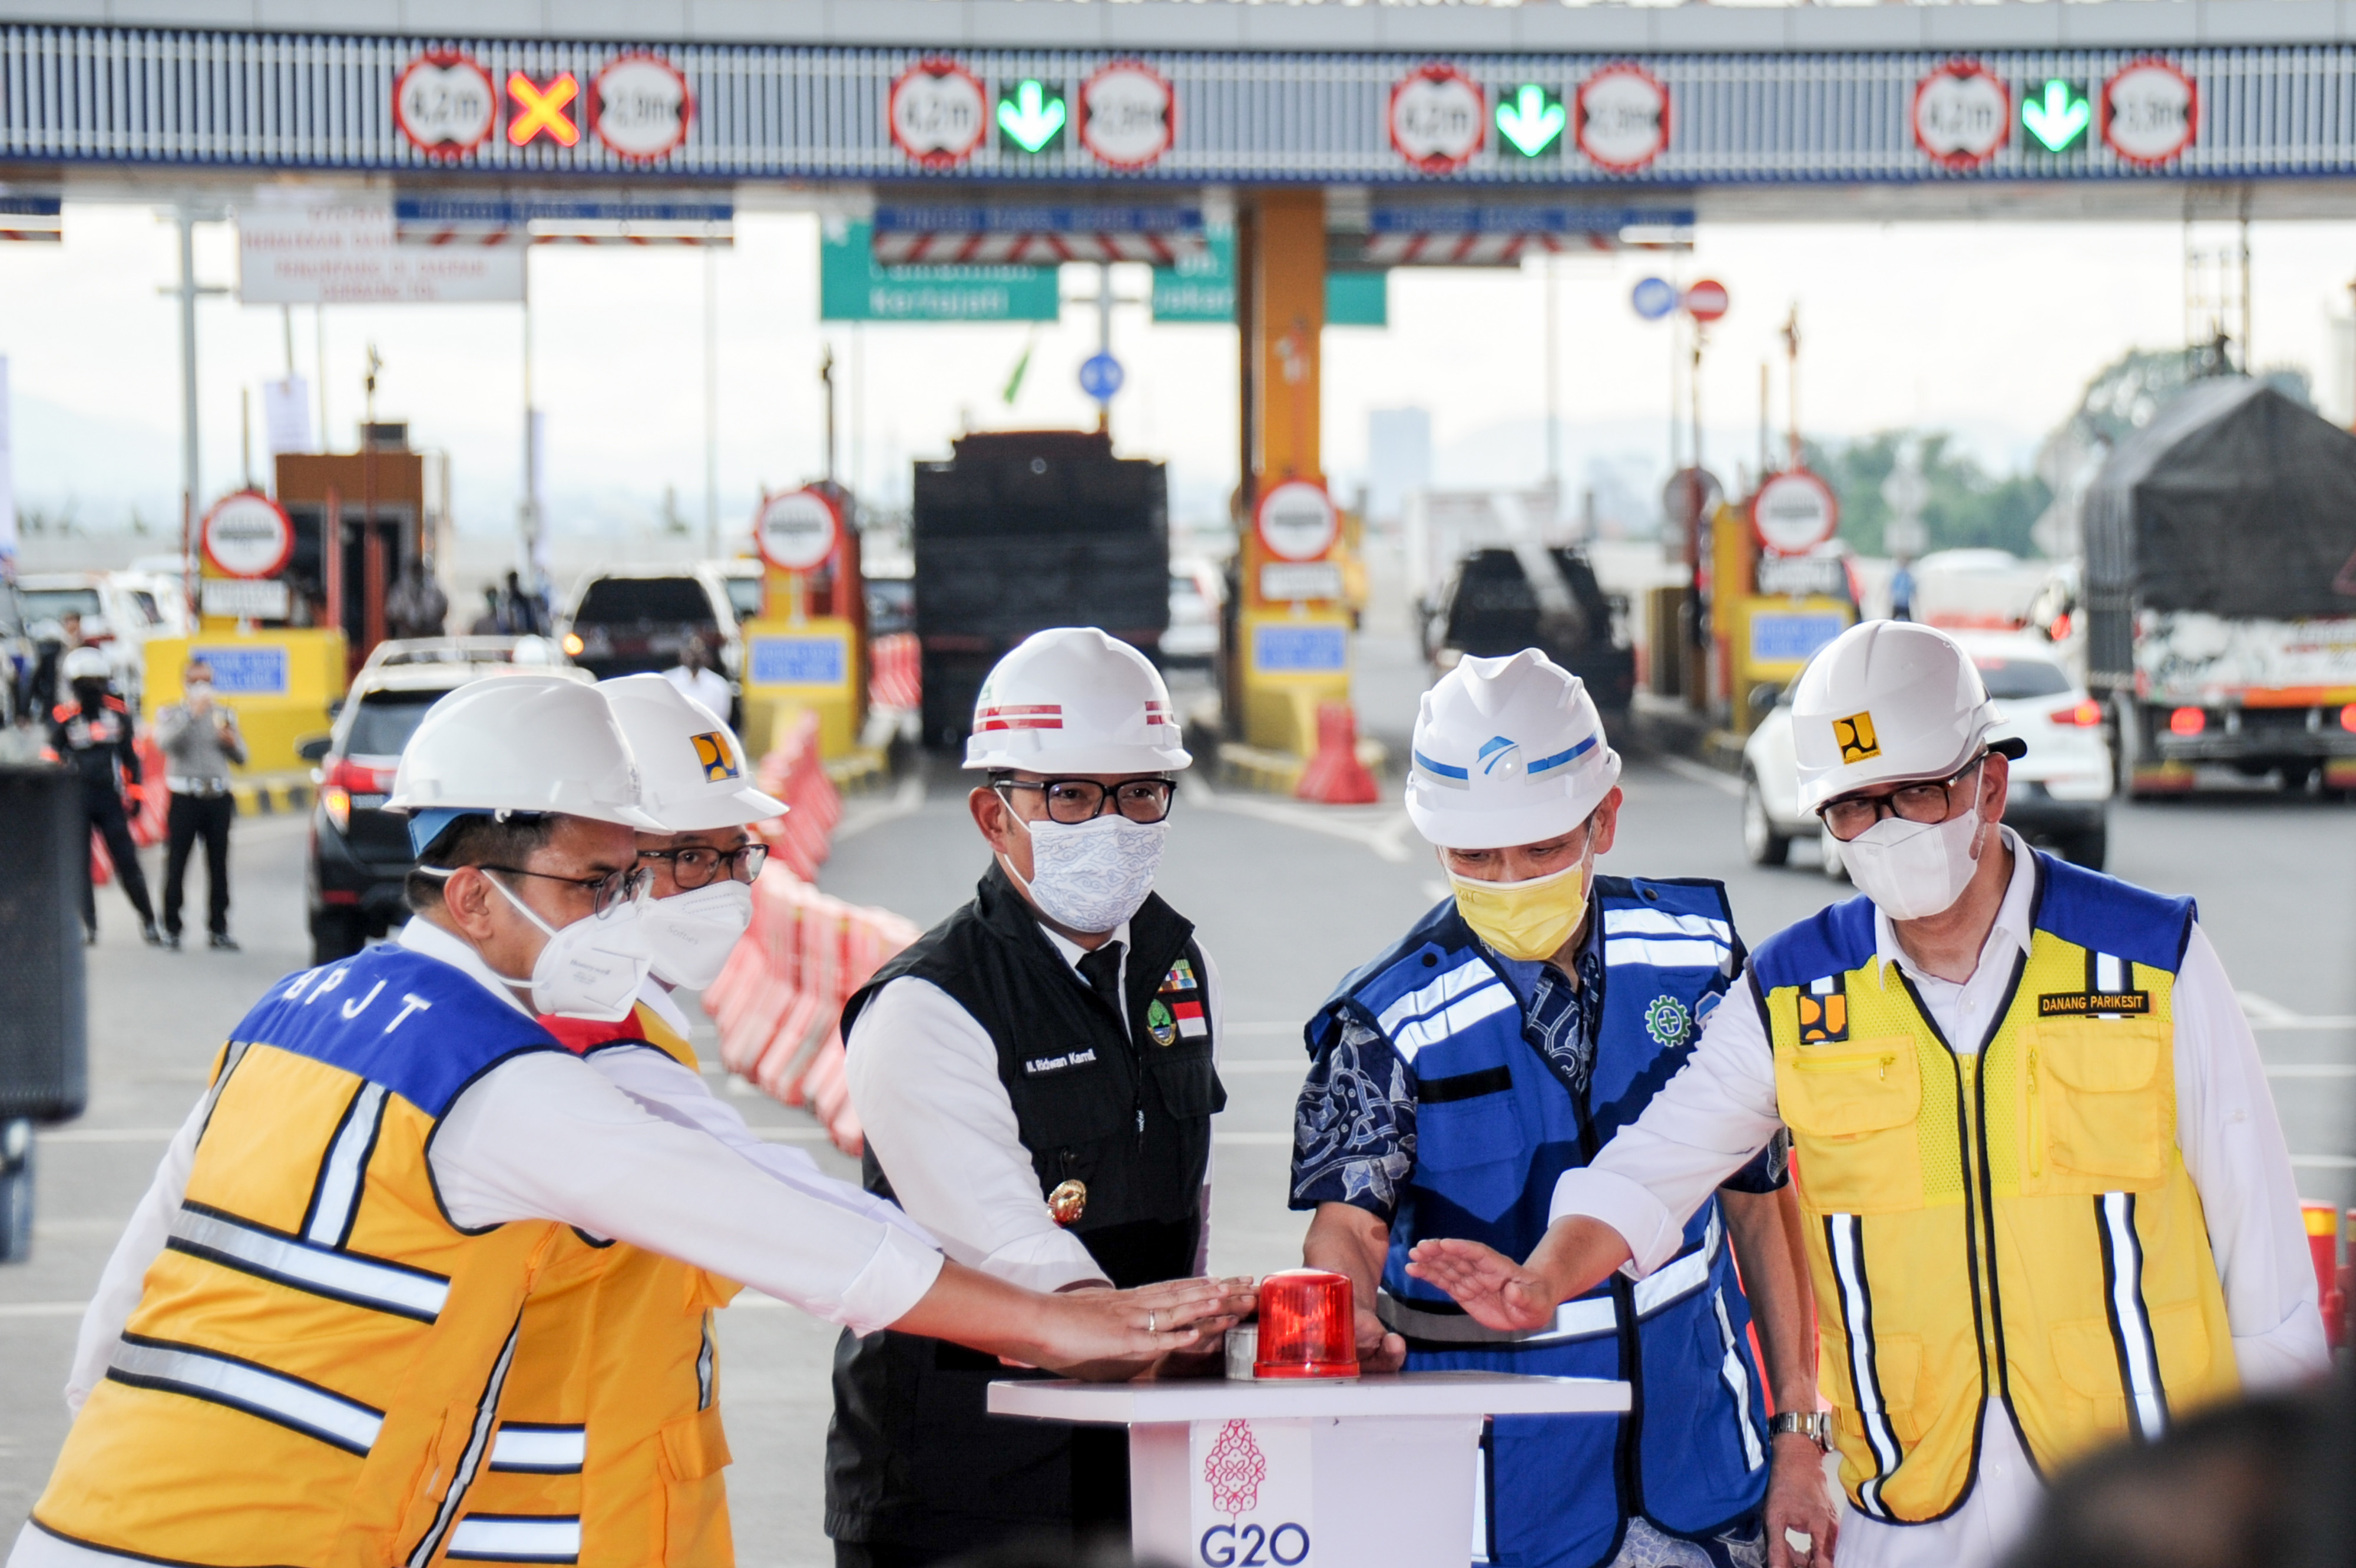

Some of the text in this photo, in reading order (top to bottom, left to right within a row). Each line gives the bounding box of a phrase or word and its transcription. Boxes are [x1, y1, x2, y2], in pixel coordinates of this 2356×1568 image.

[2042, 995, 2143, 1011] DANANG PARIKESIT
[1035, 1057, 1068, 1071] Ridwan
[1200, 1522, 1310, 1568] G20
